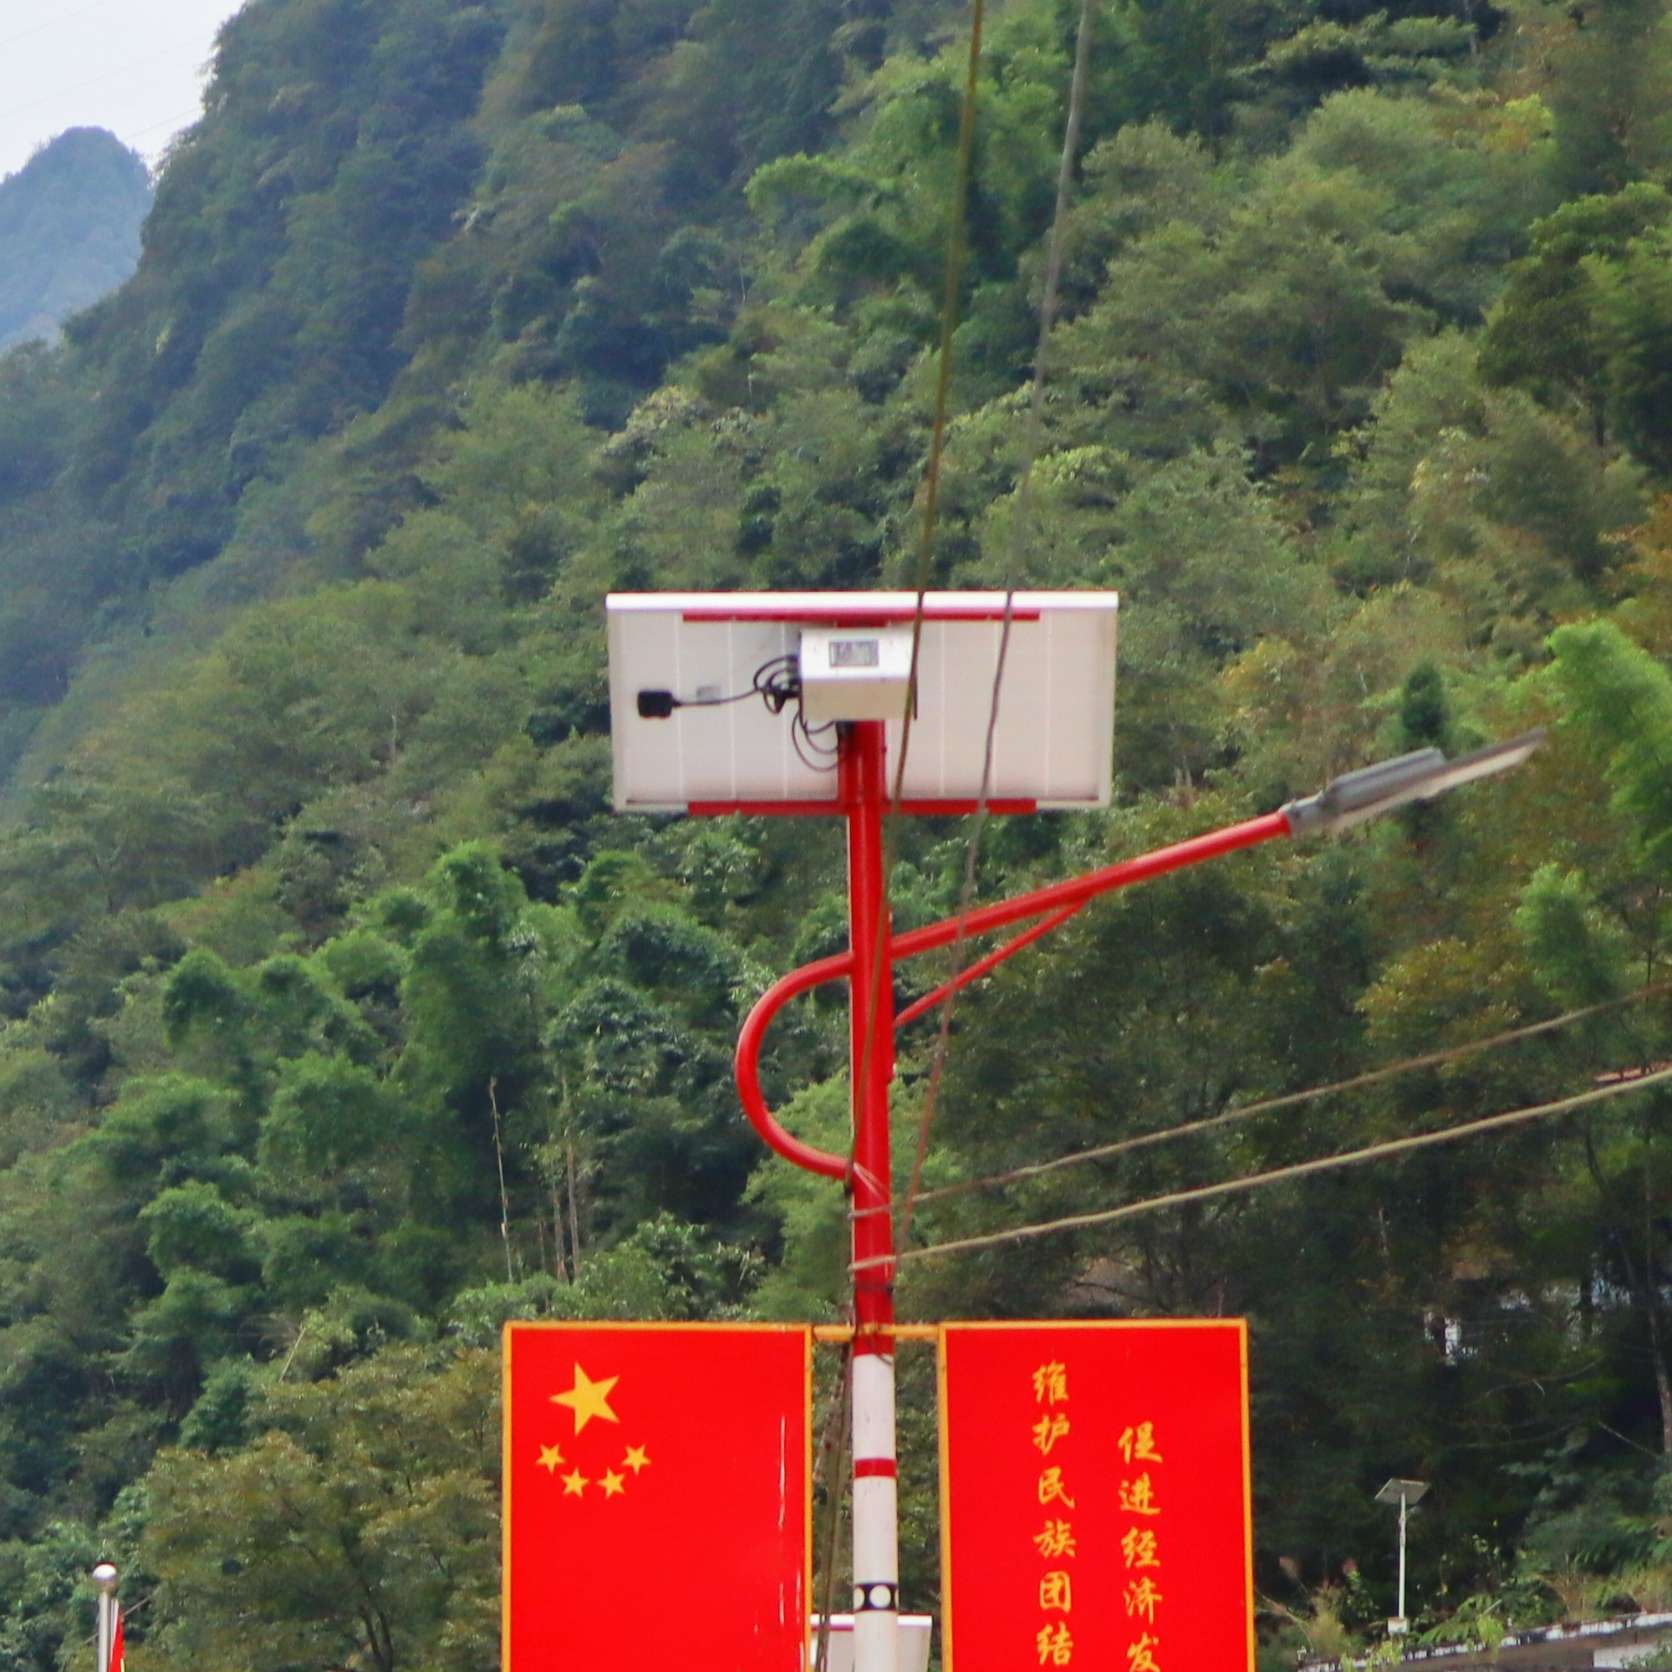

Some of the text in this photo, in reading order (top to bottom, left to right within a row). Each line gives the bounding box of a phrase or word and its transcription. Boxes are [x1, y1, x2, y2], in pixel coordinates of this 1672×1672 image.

[1032, 1360, 1077, 1666] 维护民族团结
